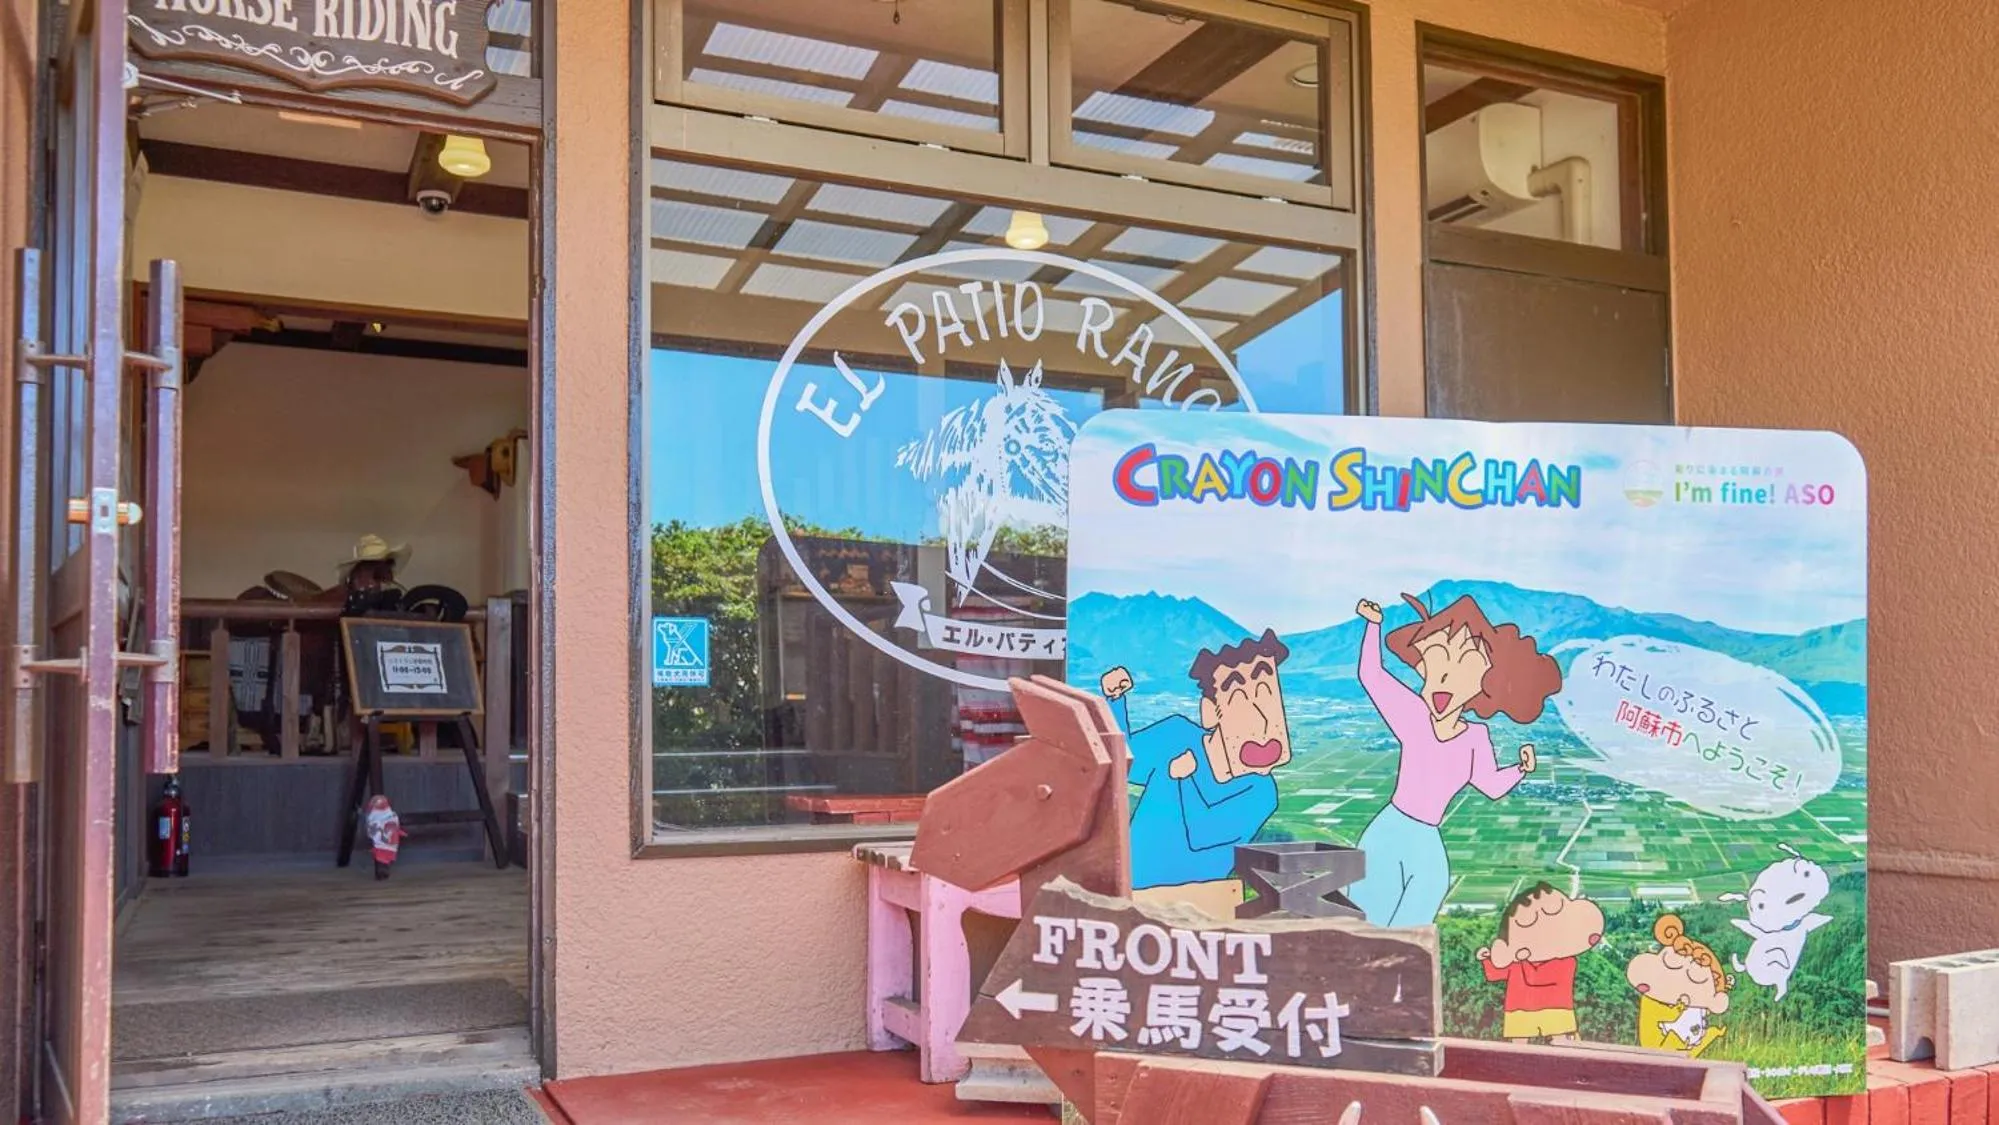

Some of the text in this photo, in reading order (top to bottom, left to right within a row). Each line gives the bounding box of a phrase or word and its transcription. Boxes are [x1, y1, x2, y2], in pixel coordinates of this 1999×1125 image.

[312, 0, 459, 59] RIDING
[796, 350, 886, 438] EL
[884, 280, 1044, 365] PATIO
[1112, 442, 1317, 510] CRAYON
[1721, 481, 1775, 505] fine!
[1784, 483, 1835, 506] ASO
[1592, 654, 1760, 742] わたしのふるさと
[1032, 915, 1272, 986] FRONT
[1069, 977, 1351, 1059] 乗馬受付
